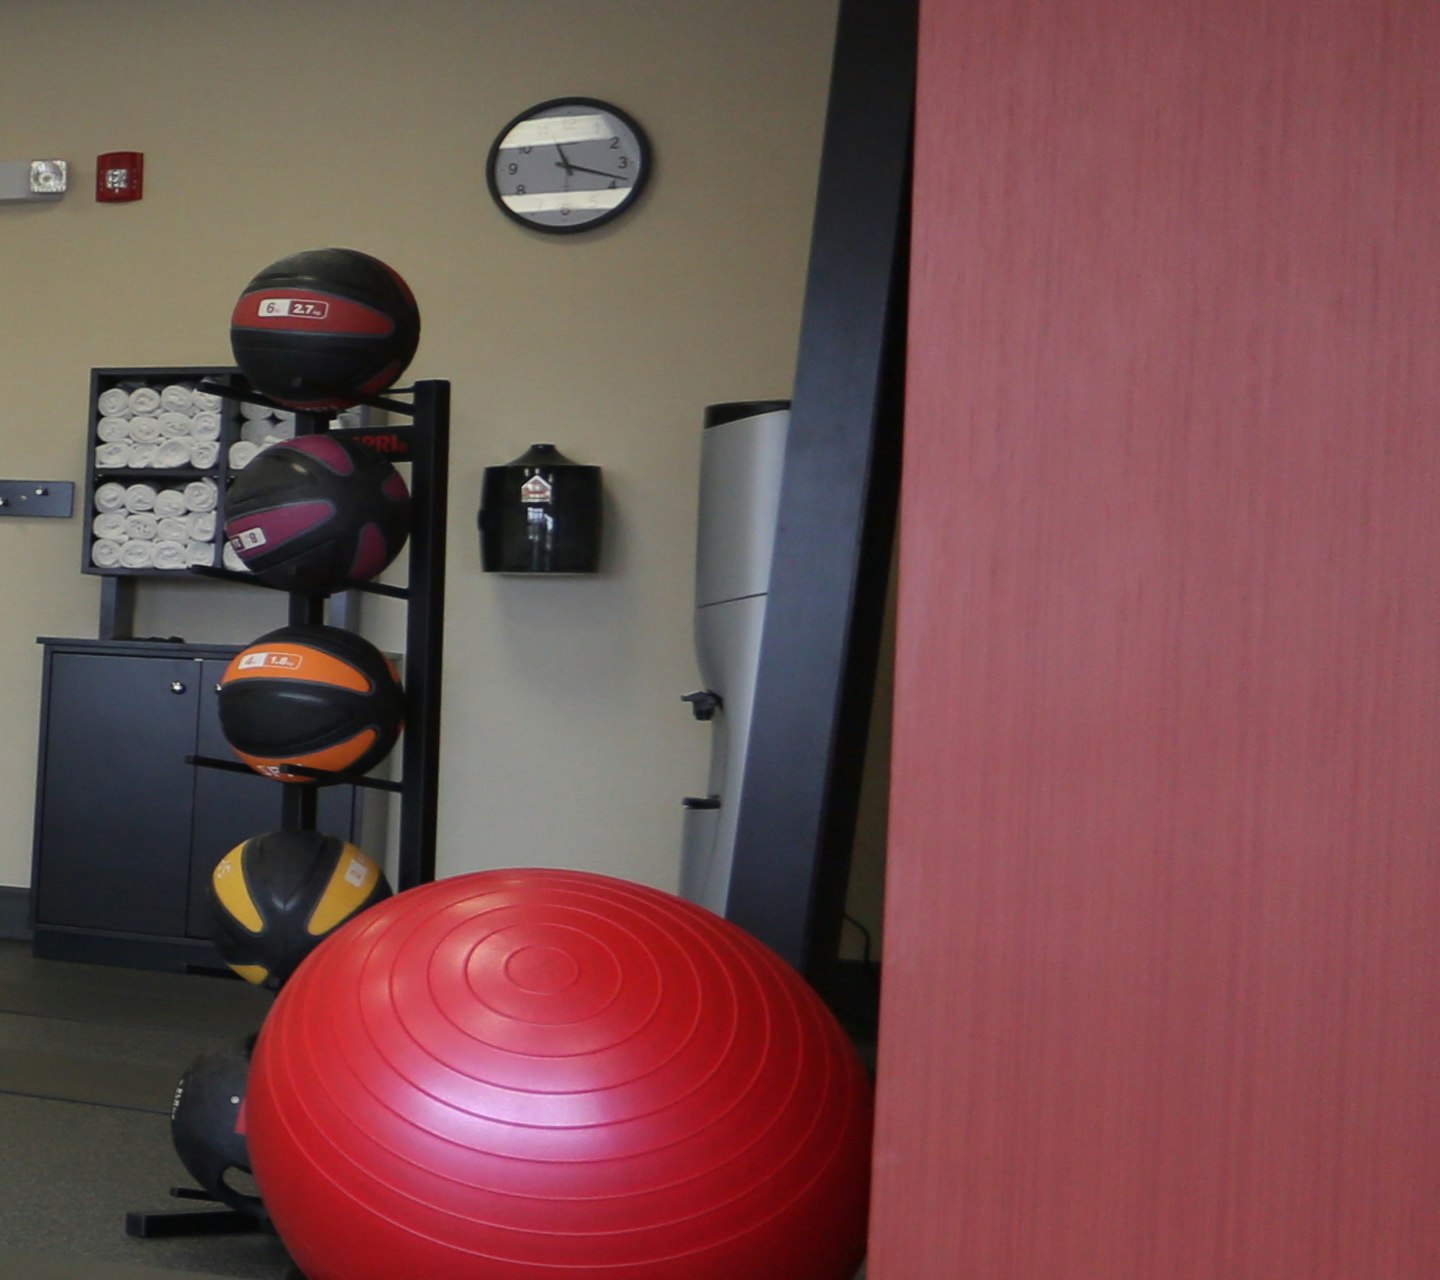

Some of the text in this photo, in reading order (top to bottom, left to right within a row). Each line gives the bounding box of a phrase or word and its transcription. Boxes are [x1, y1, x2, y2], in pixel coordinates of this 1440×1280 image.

[609, 136, 620, 149] 2
[618, 156, 628, 169] 3
[508, 163, 519, 176] 9
[516, 184, 526, 196] 8
